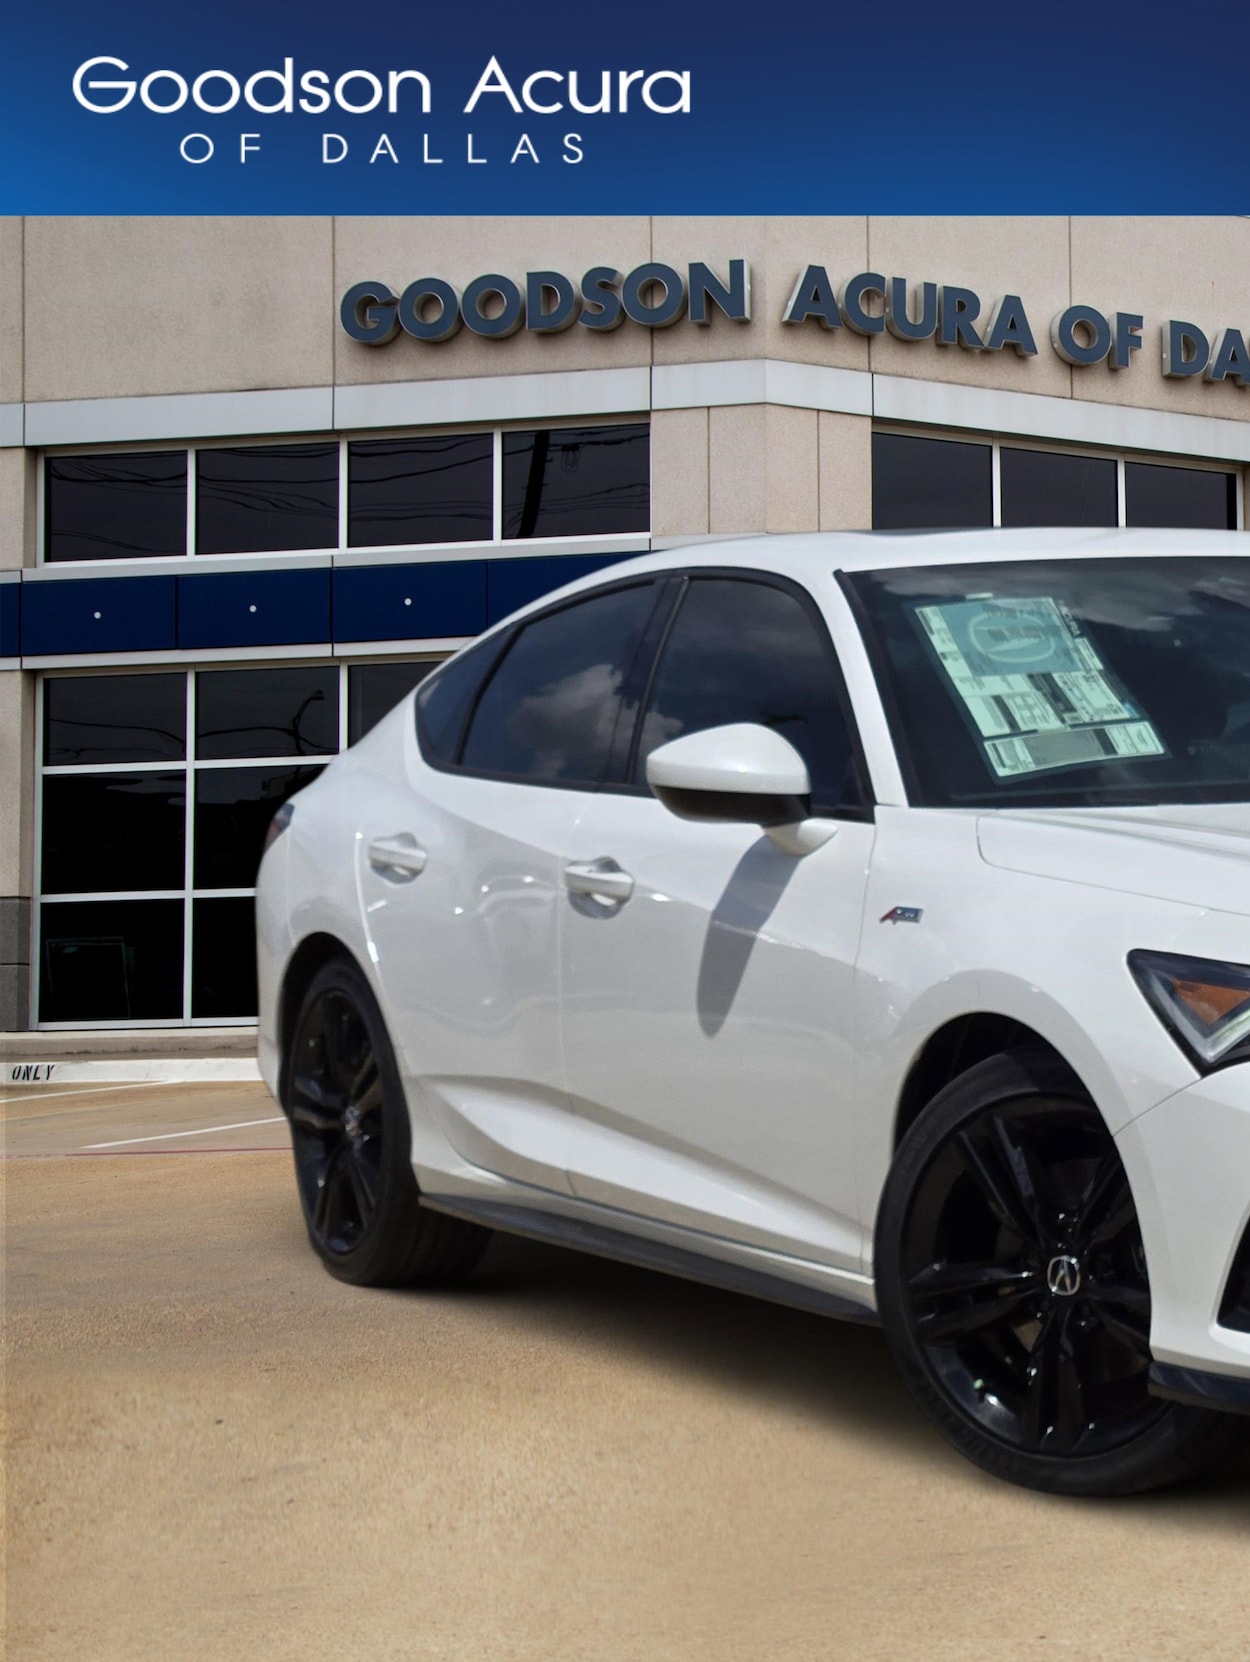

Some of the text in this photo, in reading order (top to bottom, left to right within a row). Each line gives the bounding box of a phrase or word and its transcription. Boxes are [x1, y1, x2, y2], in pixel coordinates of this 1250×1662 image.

[340, 259, 751, 345] GOODSON
[782, 264, 1038, 357] ACURA
[1051, 305, 1144, 370] OF
[12, 1064, 55, 1080] ONLY
